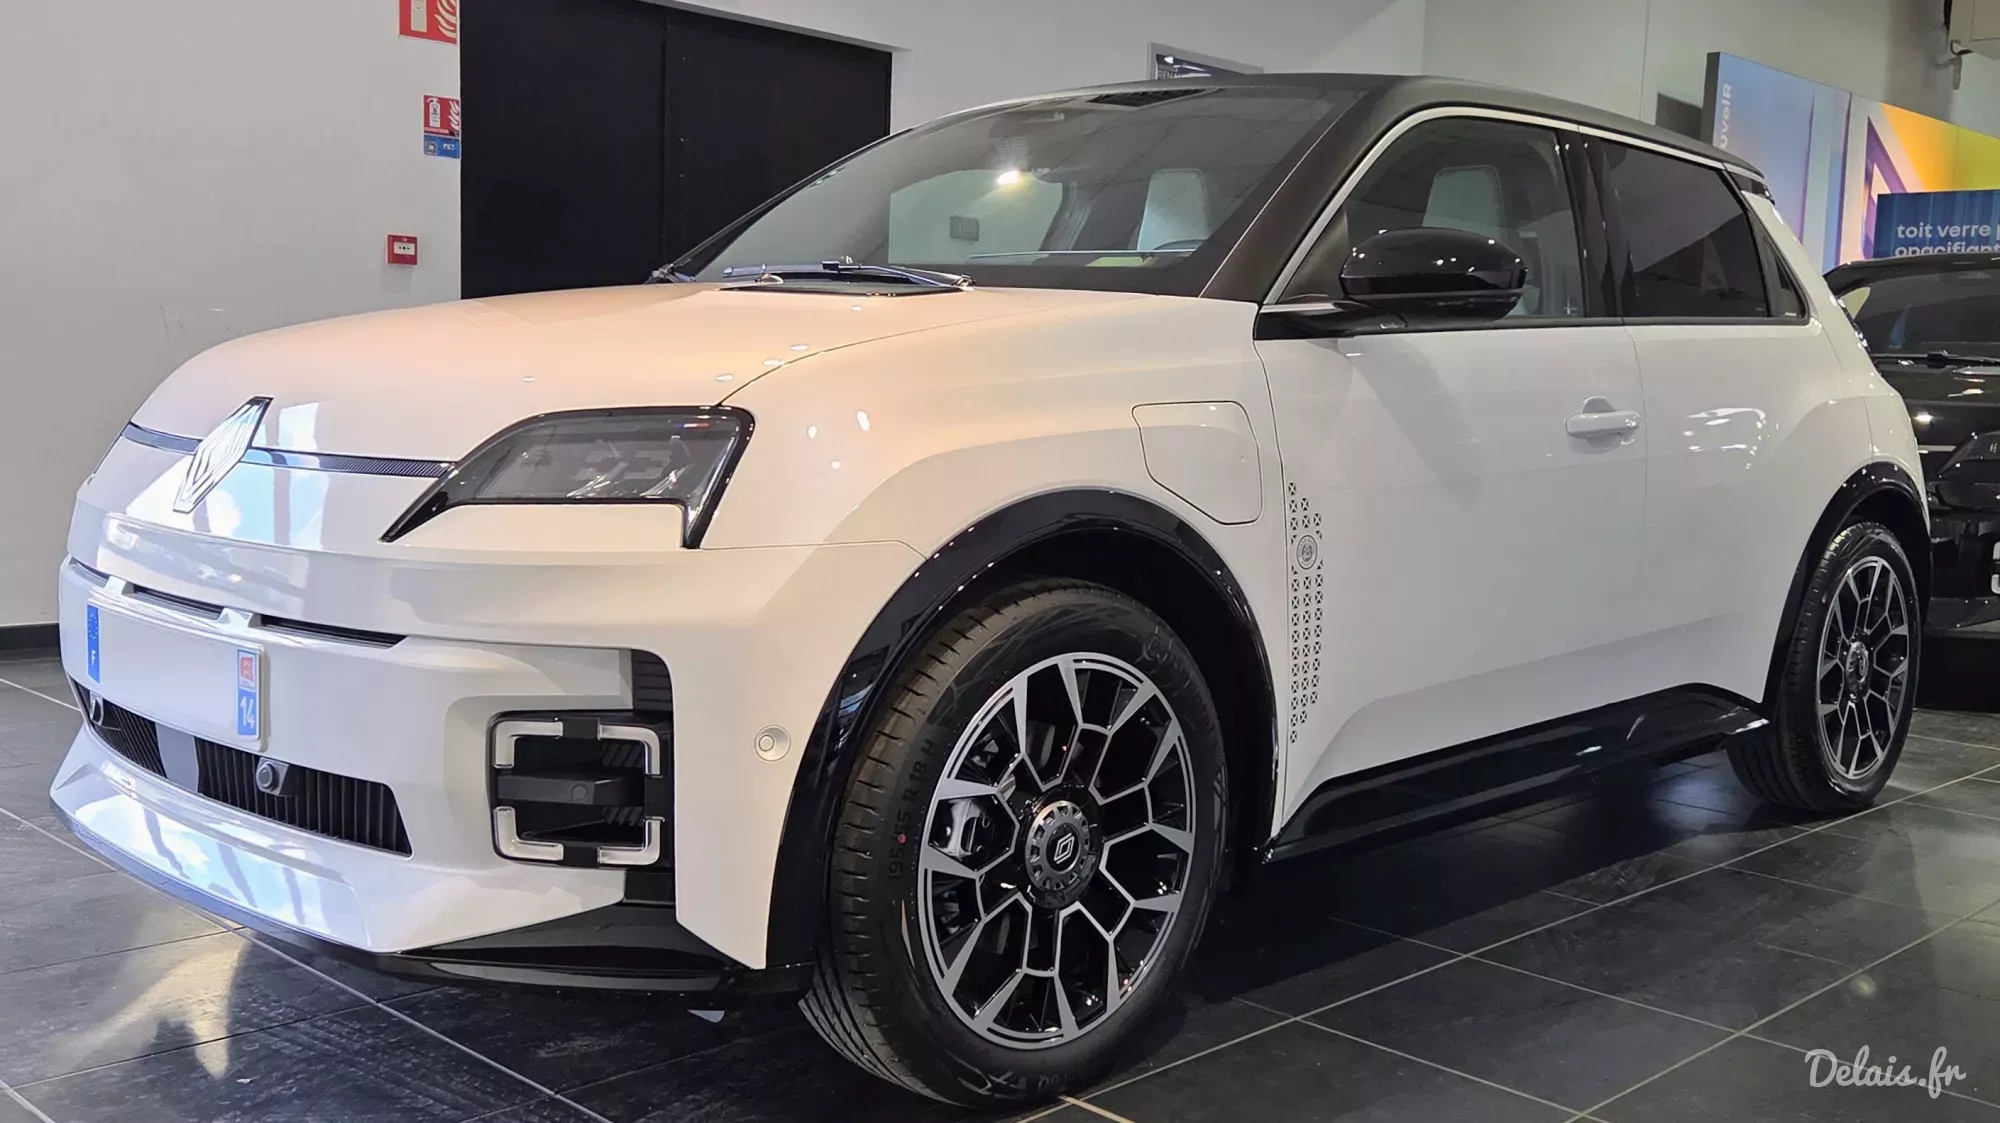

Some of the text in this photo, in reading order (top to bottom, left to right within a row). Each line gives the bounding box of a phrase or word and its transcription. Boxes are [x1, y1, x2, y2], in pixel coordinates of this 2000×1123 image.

[1896, 222, 1933, 238] toit
[1937, 224, 1991, 238] verre
[240, 696, 255, 729] 14
